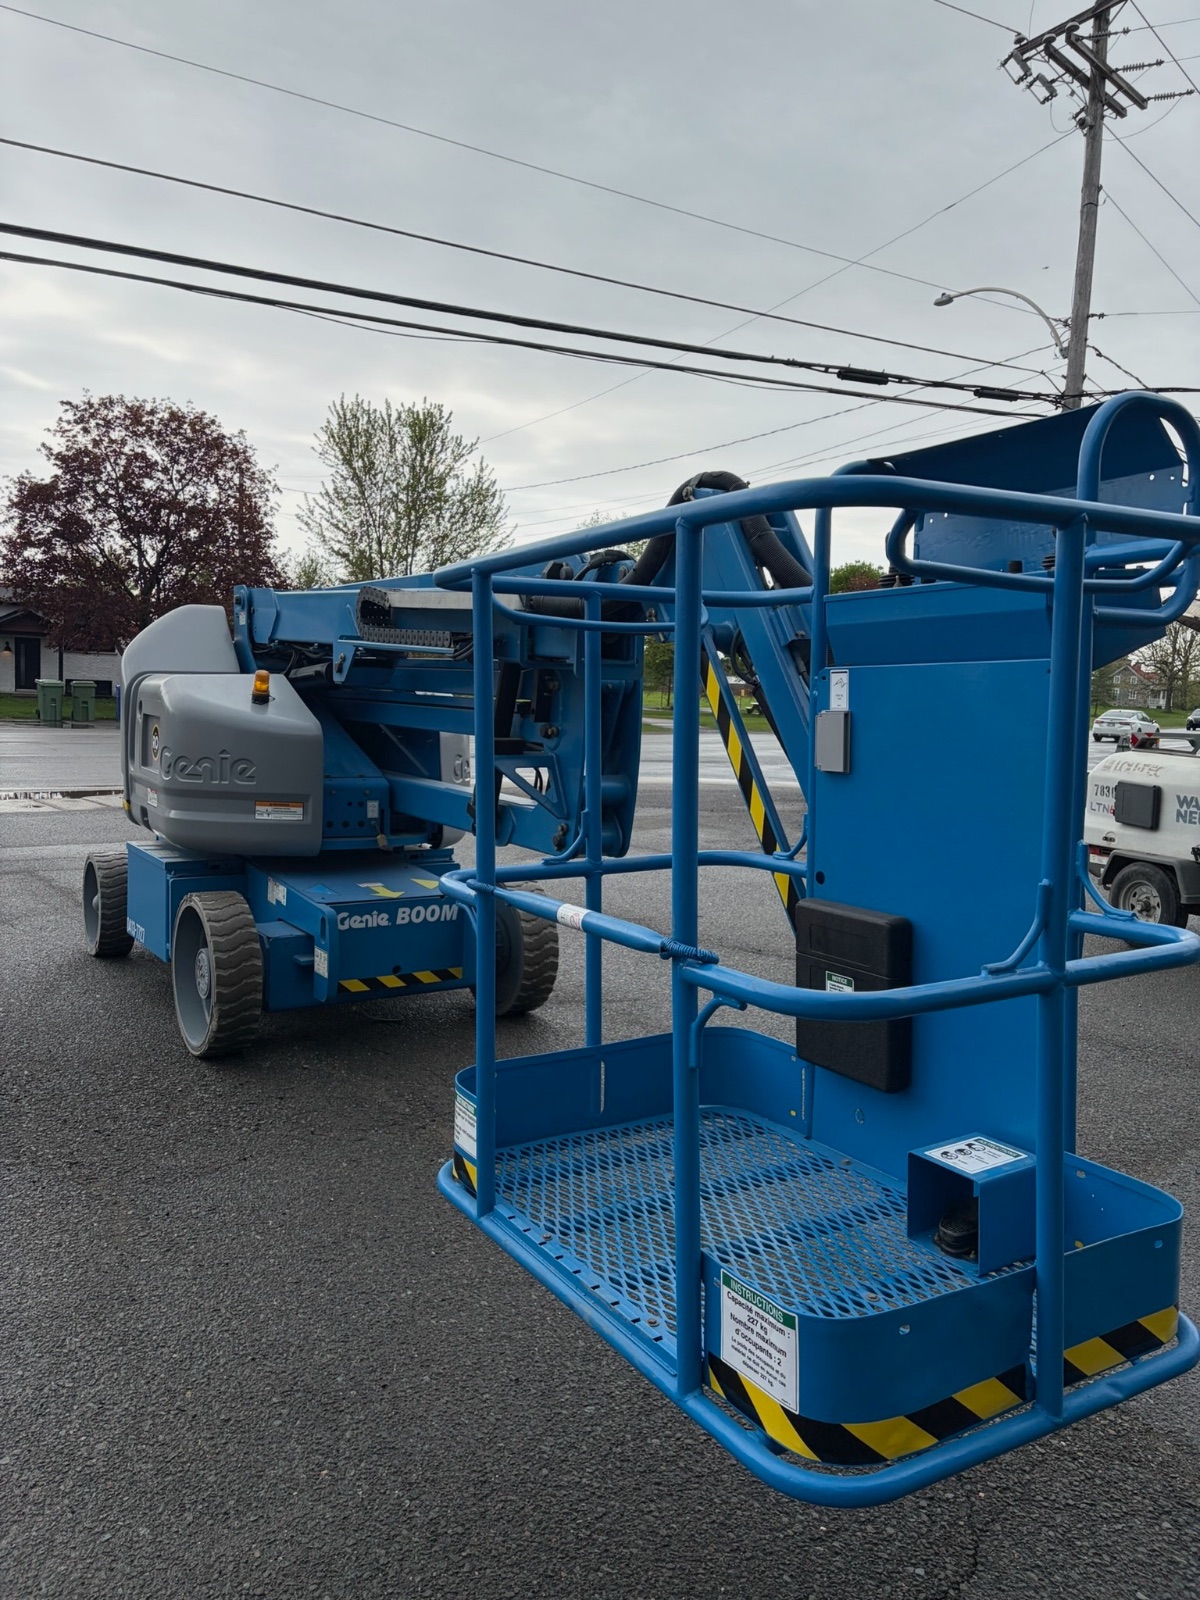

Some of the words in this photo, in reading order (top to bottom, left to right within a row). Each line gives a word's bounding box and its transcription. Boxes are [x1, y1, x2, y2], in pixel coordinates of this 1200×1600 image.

[161, 746, 257, 785] Genie
[1175, 809, 1200, 825] NE
[337, 910, 390, 931] Genie
[396, 904, 459, 925] BOOM
[726, 1291, 753, 1315] Capacité
[754, 1310, 786, 1337] maximum
[730, 1279, 784, 1323] INSTRUCTIONS
[730, 1311, 755, 1335] Nombre
[755, 1331, 787, 1358] maximum
[747, 1314, 759, 1326] 227
[760, 1322, 768, 1336] kg
[735, 1328, 773, 1360] d'occupants
[777, 1357, 782, 1367] 2
[736, 1340, 748, 1351] poids
[765, 1370, 778, 1381] aucun
